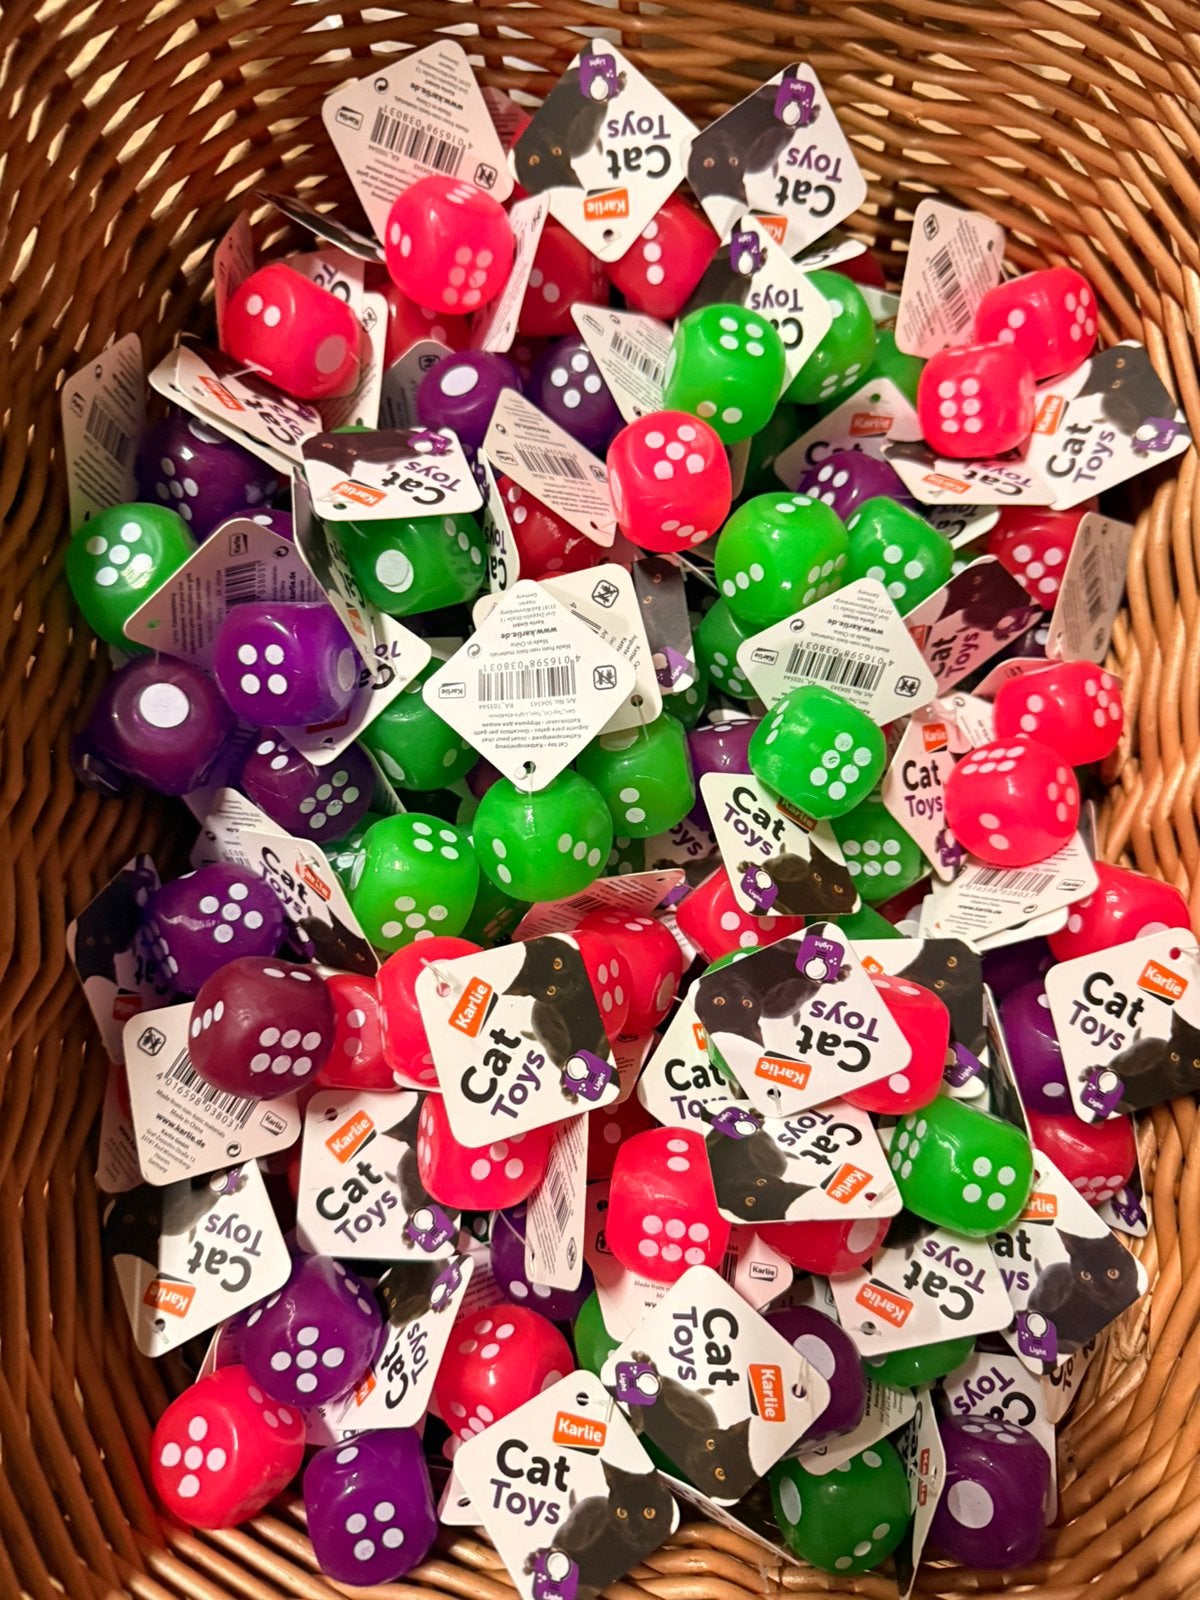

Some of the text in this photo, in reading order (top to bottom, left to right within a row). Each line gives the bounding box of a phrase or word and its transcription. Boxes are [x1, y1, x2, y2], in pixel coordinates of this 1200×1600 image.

[589, 58, 606, 66] Light
[608, 110, 671, 141] Toys
[607, 145, 671, 179] Cat
[786, 145, 843, 183] Toys
[587, 200, 626, 213] Karlie
[775, 175, 835, 218] Cat
[751, 284, 803, 313] Toys
[245, 398, 296, 446] Cat
[1037, 396, 1059, 432] Karlie
[1046, 423, 1092, 478] Cat
[1074, 430, 1115, 484] Toys
[381, 471, 446, 505] Cat
[404, 461, 462, 492] Toys
[963, 471, 1023, 497] Cat
[488, 553, 507, 590] Ca
[500, 626, 557, 640] www.karlie.de
[826, 617, 883, 637] www.karlie.de
[833, 629, 848, 637] China
[855, 634, 870, 642] Made
[482, 654, 581, 672] 4 016598 038031
[753, 651, 775, 662] Karlie
[798, 639, 894, 667] 4 016598 038031
[873, 645, 889, 653] Made
[948, 632, 979, 677] Toys
[441, 687, 463, 696] Karlie
[902, 760, 941, 791] Cat
[732, 786, 786, 841] Cat
[904, 795, 943, 820] Toys
[669, 822, 703, 855] oys
[722, 802, 773, 857] Toys
[258, 861, 304, 914] Toys
[260, 846, 311, 906] Cat
[814, 940, 835, 951] Light
[1144, 966, 1183, 996] Karlie
[456, 984, 488, 1029] Karlie
[1083, 971, 1145, 1028] Cat
[809, 999, 880, 1043] Toys
[1069, 1000, 1125, 1051] Toys
[460, 1028, 522, 1104] Cat
[796, 1024, 872, 1073] Cat
[490, 1049, 545, 1119] Toys
[593, 1072, 606, 1091] Light
[664, 1058, 726, 1091] Cat
[760, 1060, 807, 1085] Karlie
[154, 1070, 241, 1132] 4 016598 038031
[155, 1088, 171, 1101] Made
[154, 1111, 207, 1148] www.karlie.de
[169, 1108, 185, 1121] Made
[188, 1120, 204, 1133] China
[265, 1114, 283, 1131] Karlie
[331, 1119, 371, 1153] Karlie
[777, 1109, 835, 1147] Toys
[800, 1122, 862, 1167] Cat
[316, 1161, 383, 1221] Cat
[830, 1168, 866, 1201] Karlie
[334, 1190, 398, 1243] Toys
[204, 1213, 263, 1257] Toys
[432, 1230, 447, 1245] Light
[993, 1229, 1032, 1261] at
[187, 1240, 252, 1293] Cat
[752, 1266, 775, 1277] Karlie
[922, 1239, 986, 1294] Toys
[862, 1286, 907, 1321] Karlie
[902, 1260, 974, 1321] Cat
[407, 1322, 429, 1385] Toys
[669, 1306, 698, 1381] Toys
[702, 1307, 740, 1386] Cat
[1029, 1346, 1048, 1357] Light
[380, 1341, 409, 1409] Cat
[761, 1368, 776, 1418] Karlie
[954, 1366, 1015, 1415] Toys
[558, 1418, 603, 1442] Karlie
[496, 1439, 570, 1492] Cat
[490, 1478, 561, 1526] Toys
